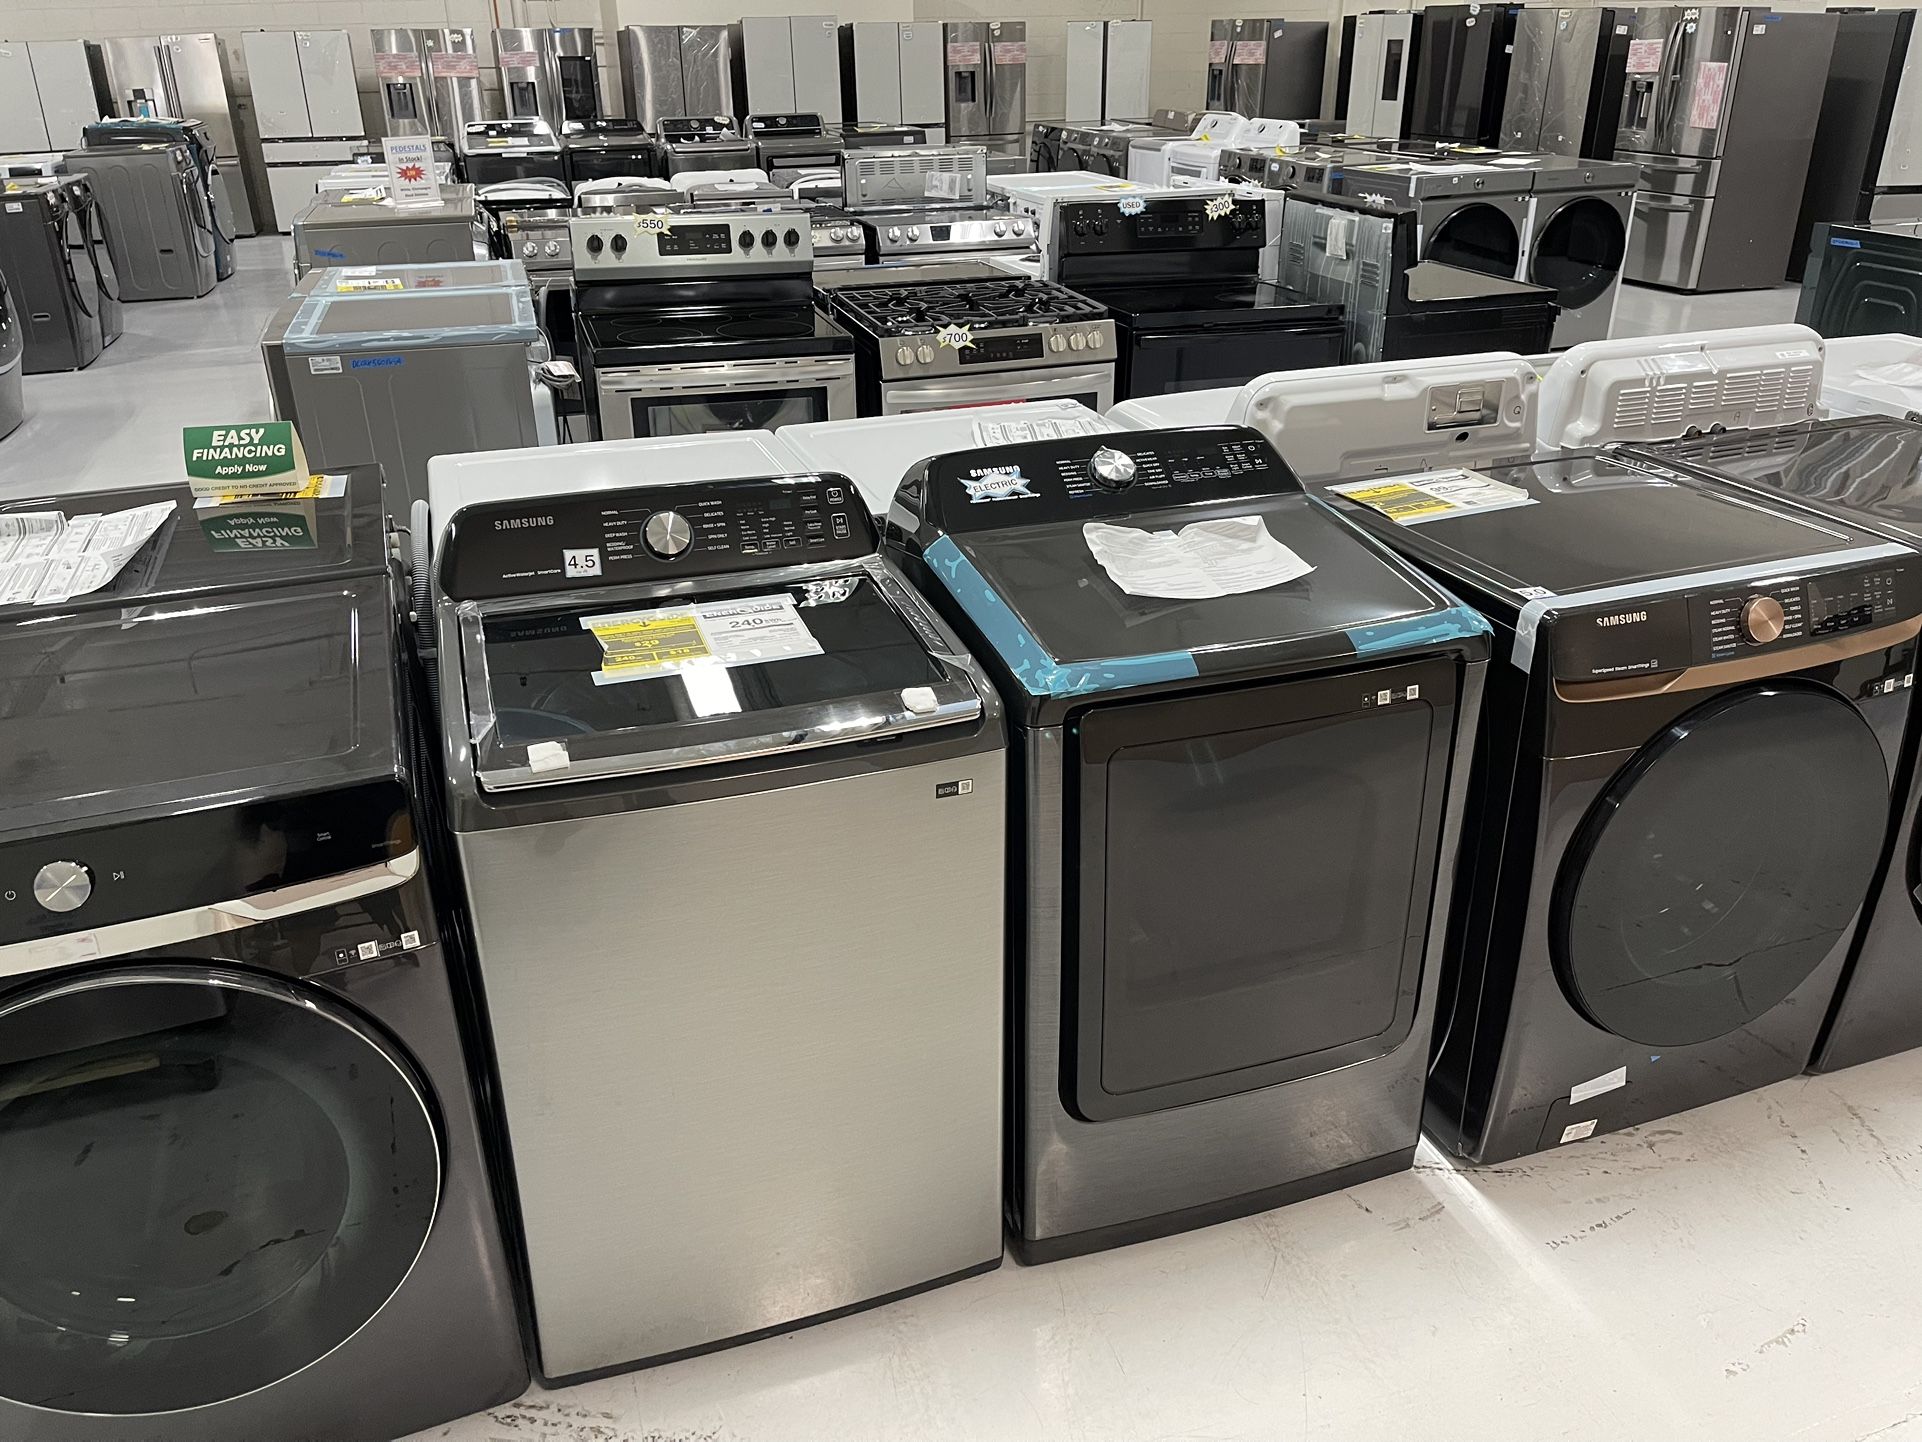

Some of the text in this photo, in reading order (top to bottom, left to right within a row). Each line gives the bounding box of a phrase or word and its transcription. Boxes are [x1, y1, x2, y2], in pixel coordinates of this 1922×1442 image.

[390, 144, 427, 153] PEDESTALS
[1122, 201, 1141, 209] USED
[1210, 200, 1230, 213] $300
[637, 219, 663, 229] $550
[942, 332, 968, 343] $700
[211, 428, 265, 446] EASY
[192, 444, 286, 461] FINANCING
[215, 463, 267, 475] Apply Now
[973, 478, 1018, 493] ELECTRIC
[494, 516, 554, 530] SAMSUNG
[567, 555, 596, 569] 4.5
[1596, 611, 1647, 627] SAMSUNG
